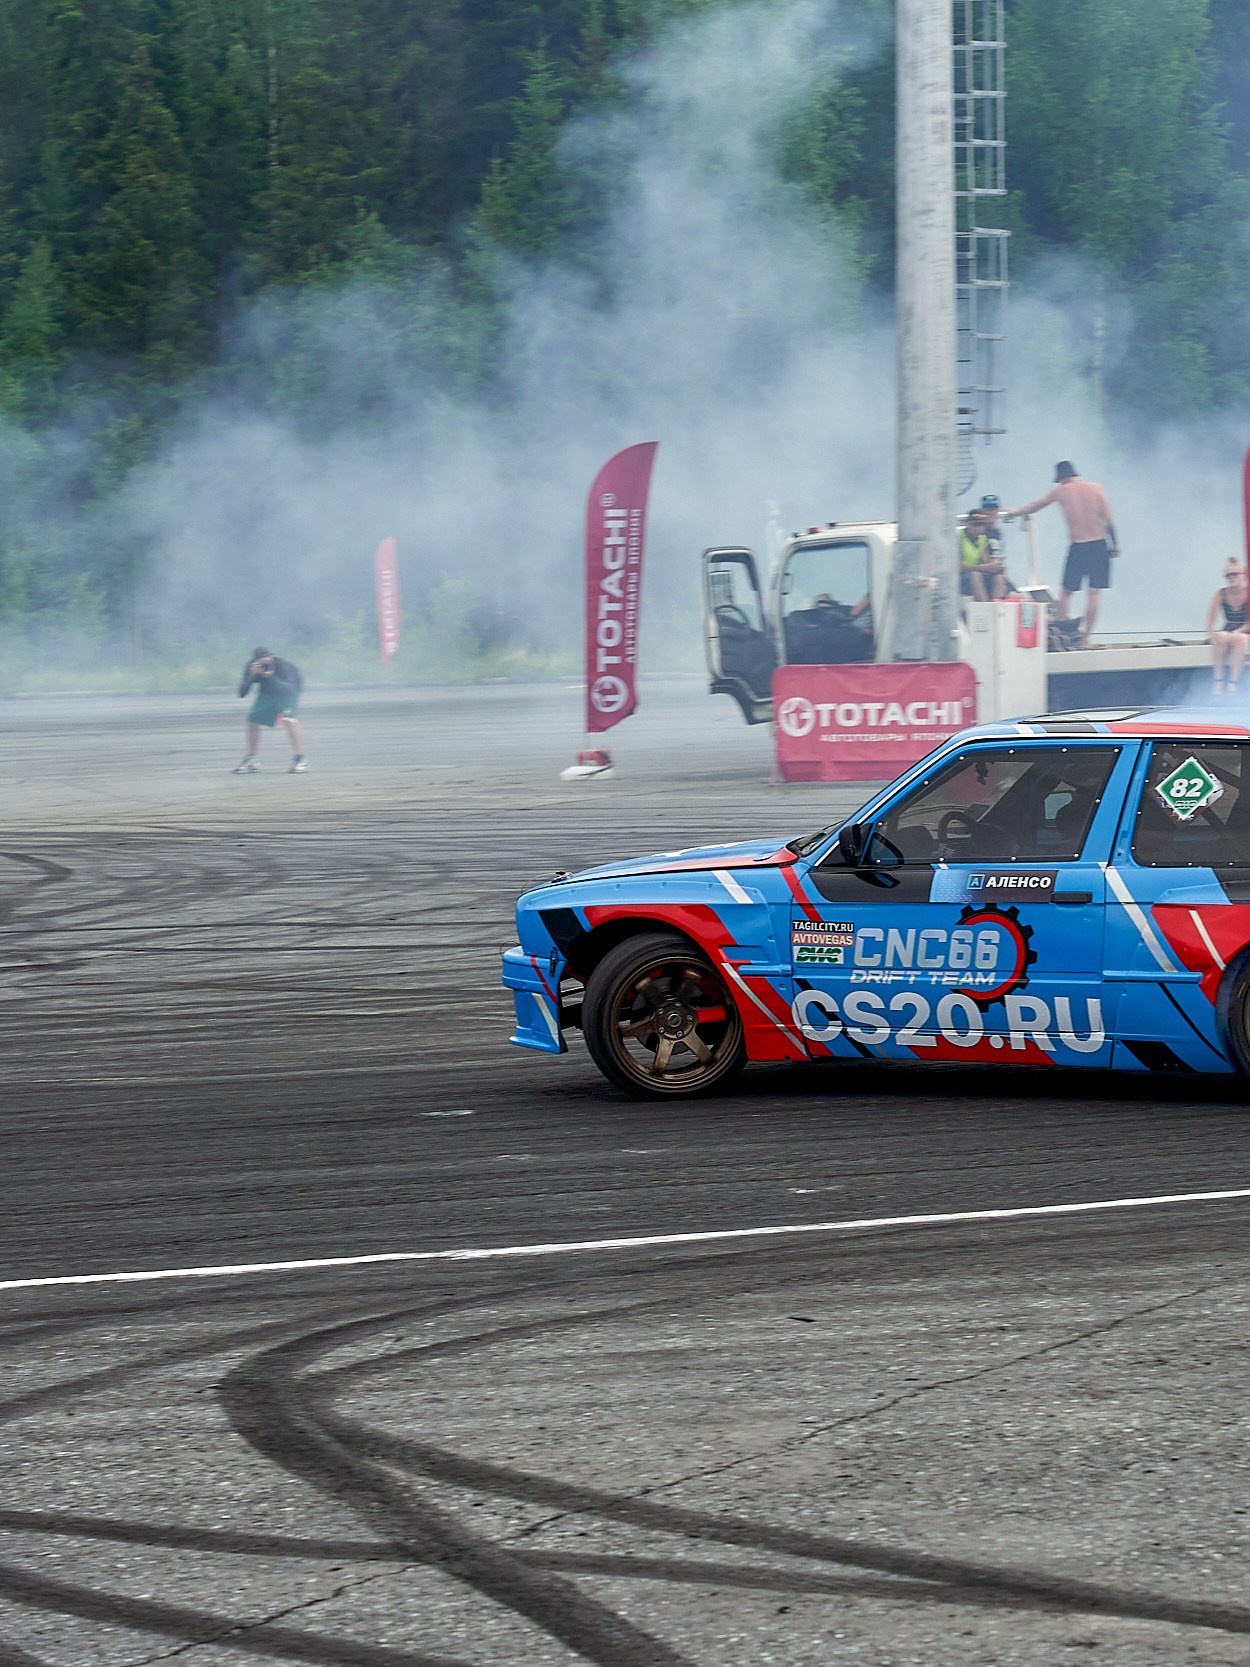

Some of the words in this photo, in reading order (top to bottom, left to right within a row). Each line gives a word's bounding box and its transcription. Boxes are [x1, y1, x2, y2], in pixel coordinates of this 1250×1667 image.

[596, 508, 629, 673] TOTACHI
[814, 700, 962, 727] TOTACHI
[1169, 777, 1204, 798] 82
[985, 876, 1052, 889] АЛЕНСО
[793, 921, 854, 932] TAGILCITY.RU
[793, 933, 854, 946] AVTOVEGAS
[854, 927, 1000, 968] CNC66
[927, 971, 996, 986] TEAM
[791, 989, 1106, 1054] CS20.RU
